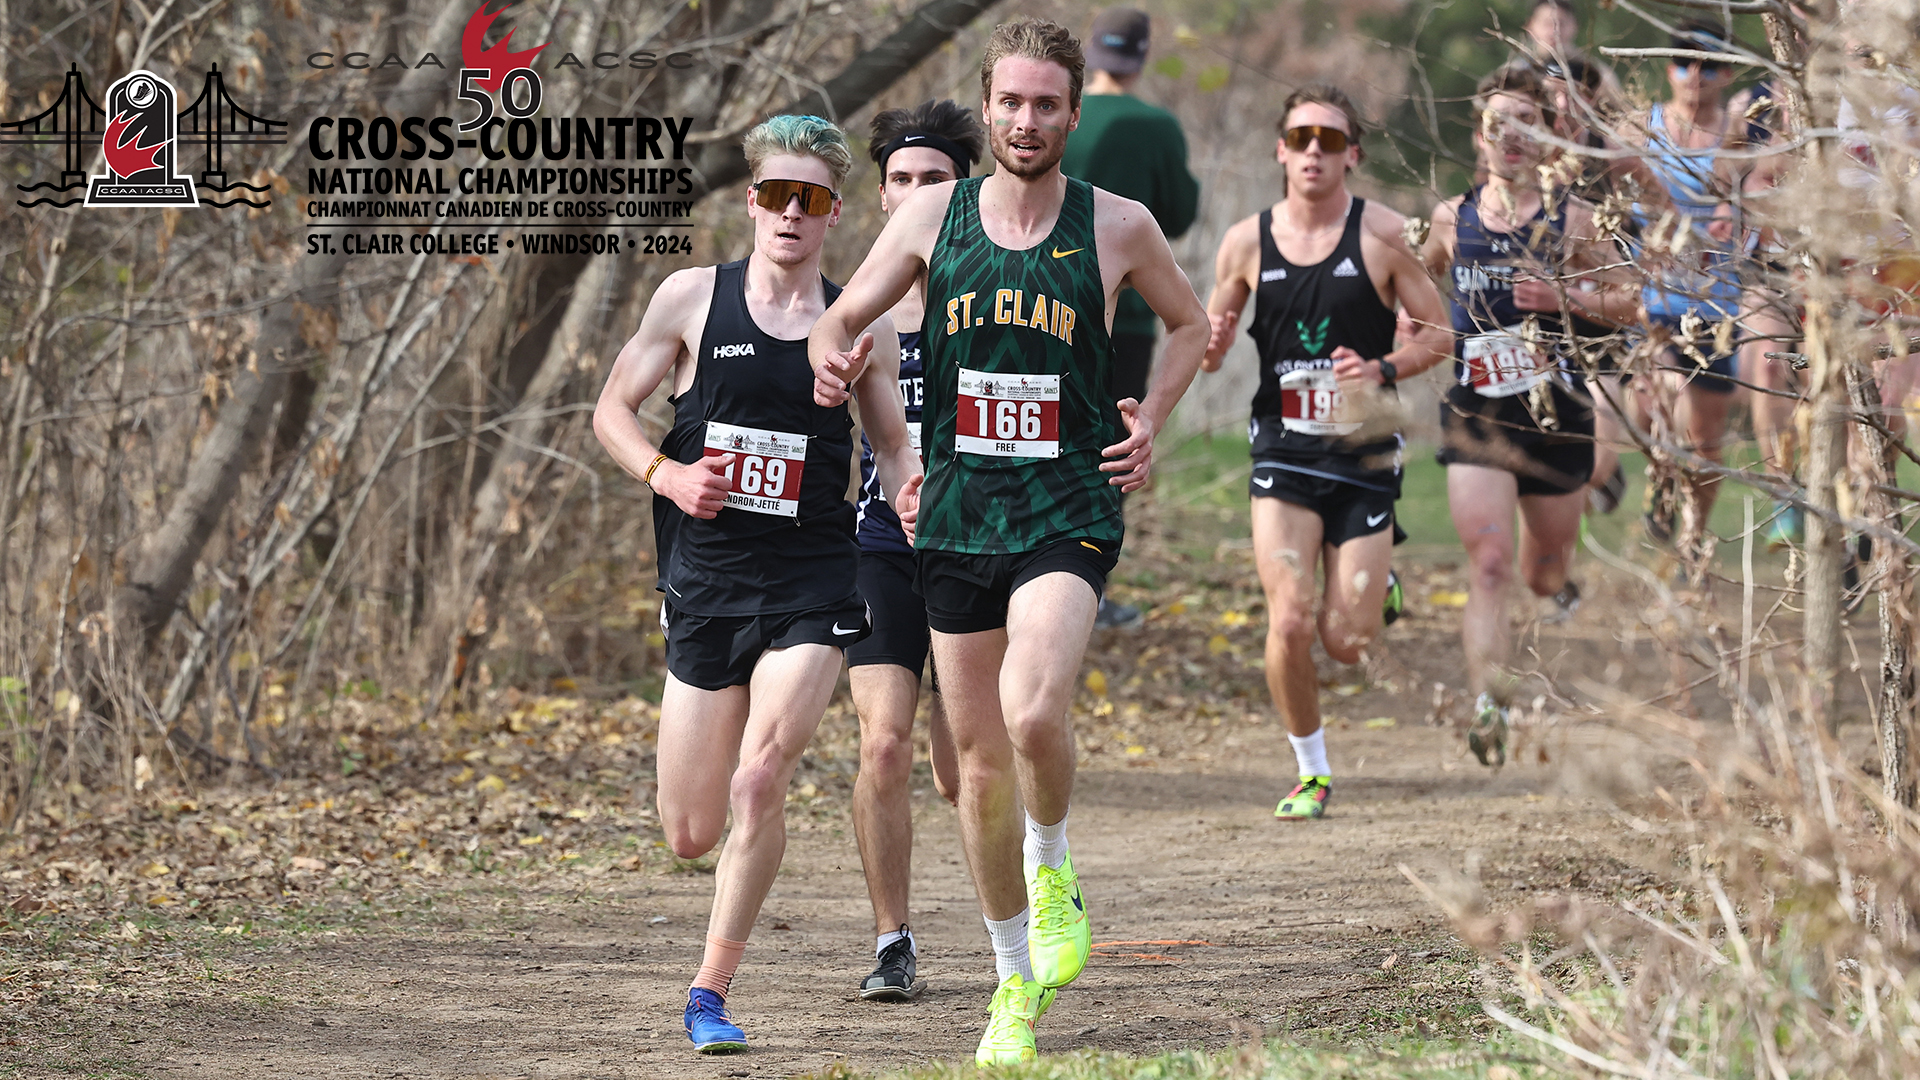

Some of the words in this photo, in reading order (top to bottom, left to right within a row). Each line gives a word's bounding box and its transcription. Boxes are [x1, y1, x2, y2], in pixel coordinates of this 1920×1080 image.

[946, 291, 984, 336] ST.
[994, 288, 1077, 347] CLAIR
[713, 343, 756, 359] HOKA
[974, 399, 1042, 440] 166
[995, 443, 1017, 453] FREE
[722, 452, 787, 498] 169
